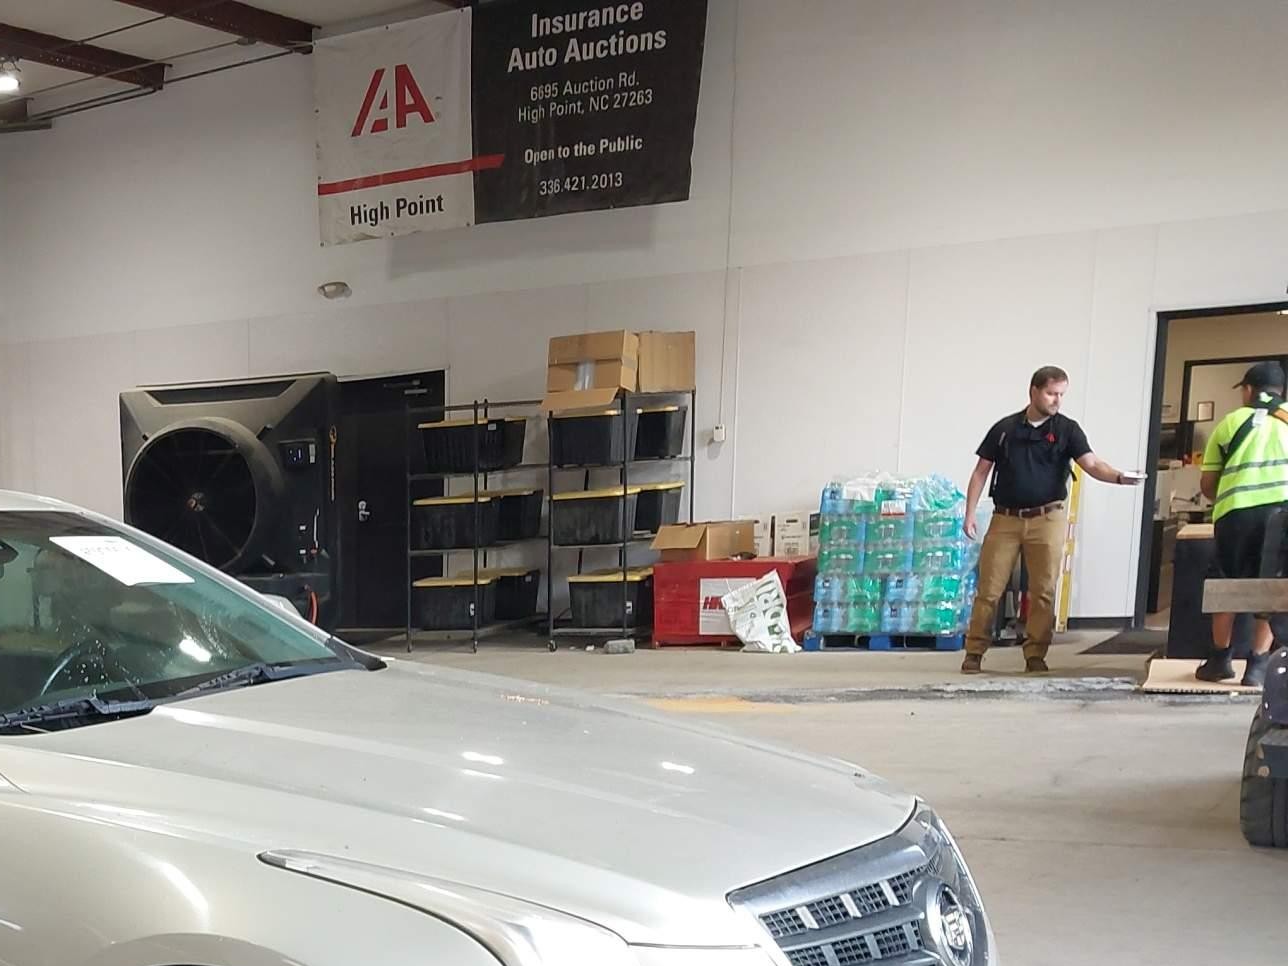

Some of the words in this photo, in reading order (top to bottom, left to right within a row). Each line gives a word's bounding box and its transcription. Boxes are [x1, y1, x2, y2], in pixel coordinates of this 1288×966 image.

[531, 0, 644, 38] Insurance
[507, 46, 558, 73] Auto
[564, 28, 667, 63] Auctions
[530, 82, 559, 101] 6695
[563, 77, 614, 97] Auction
[618, 71, 640, 88] Rd.
[517, 105, 546, 124] High
[550, 101, 585, 117] Point,
[589, 95, 609, 111] NC
[613, 89, 653, 109] 27263
[524, 147, 555, 165] Open
[558, 144, 570, 158] to
[573, 141, 596, 156] the
[599, 136, 643, 153] Public
[539, 172, 623, 196] 336.421.2013
[350, 203, 389, 227] High
[396, 194, 444, 219] Point
